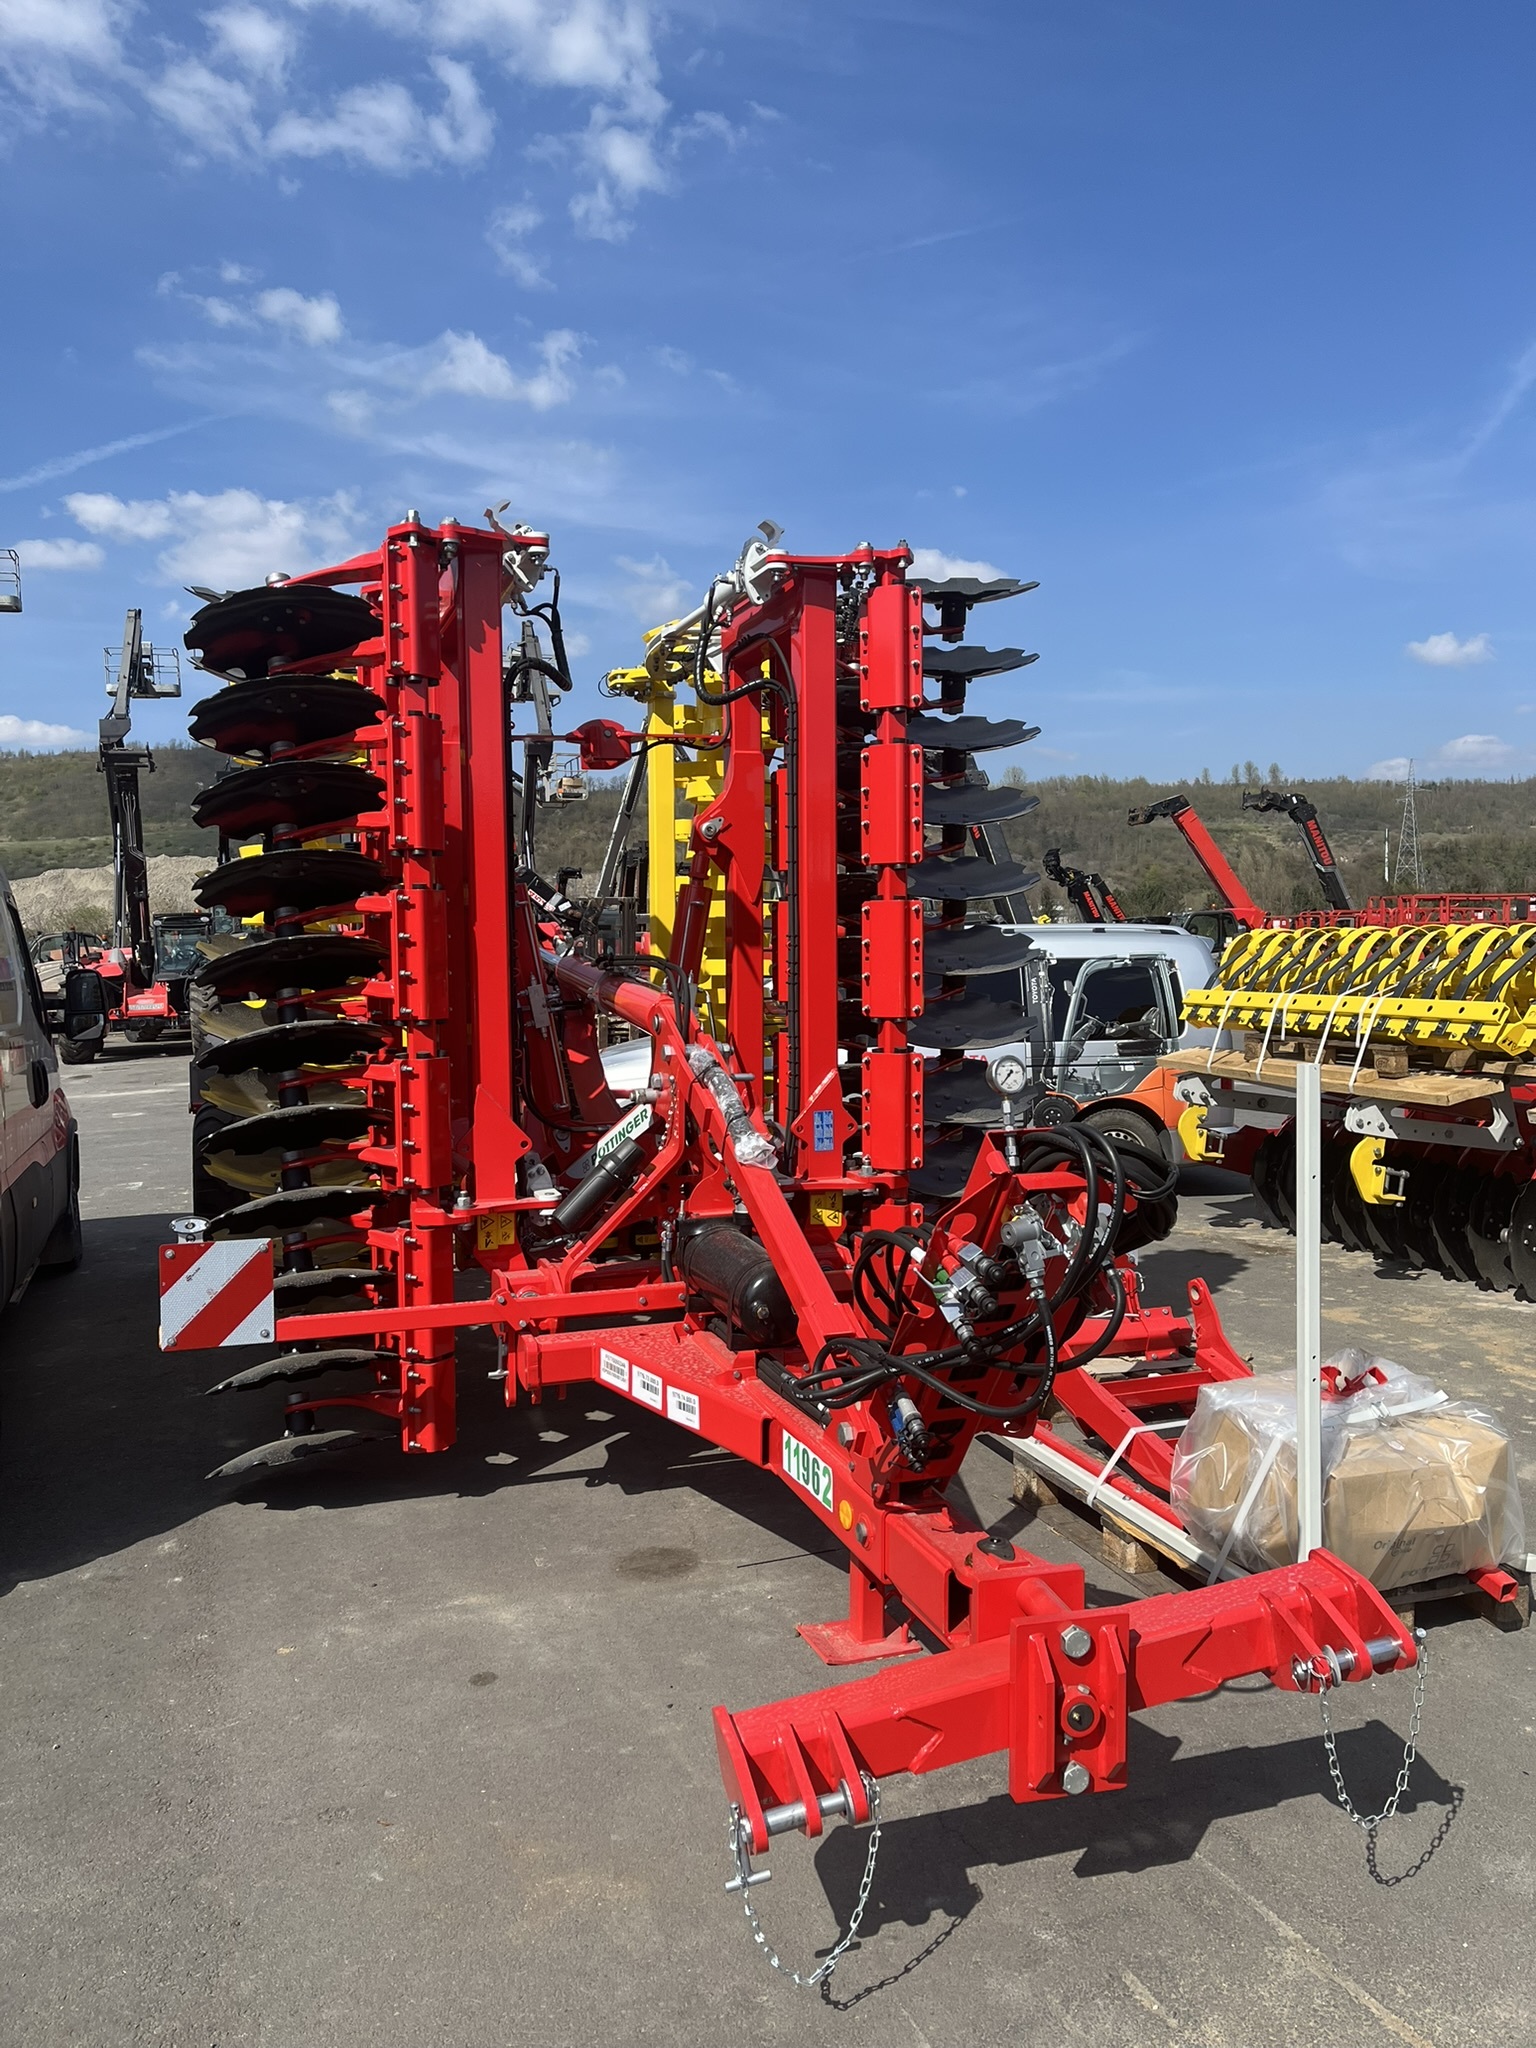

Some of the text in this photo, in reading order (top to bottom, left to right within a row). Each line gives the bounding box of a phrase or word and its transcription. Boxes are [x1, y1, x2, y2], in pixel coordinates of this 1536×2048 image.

[1306, 819, 1333, 866] MANITOU
[1105, 894, 1127, 920] MANIT
[1031, 976, 1039, 1004] TOYOTA
[785, 1435, 832, 1509] 11962
